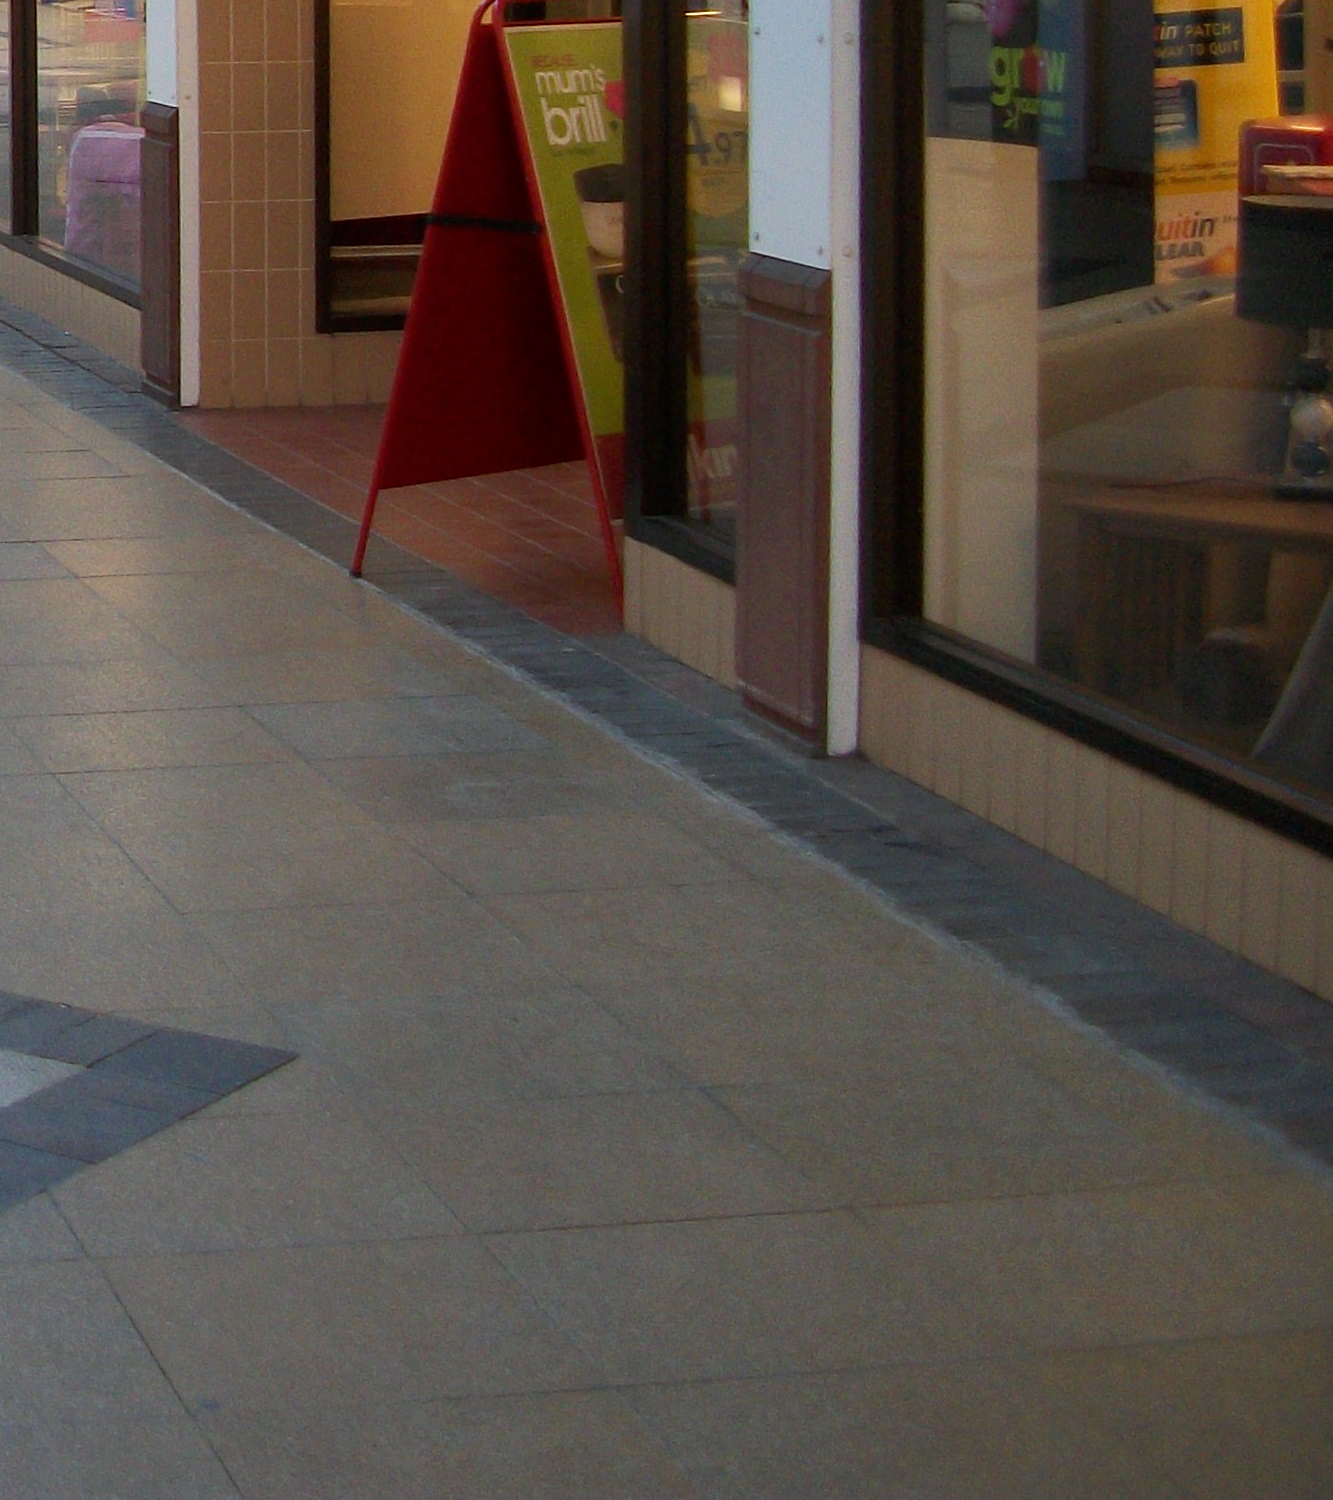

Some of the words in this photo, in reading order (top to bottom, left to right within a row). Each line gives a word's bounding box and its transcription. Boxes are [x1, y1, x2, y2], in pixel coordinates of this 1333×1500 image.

[1184, 21, 1232, 38] PATCH
[1189, 44, 1205, 57] TO
[535, 63, 606, 95] mum's
[540, 94, 607, 146] brill
